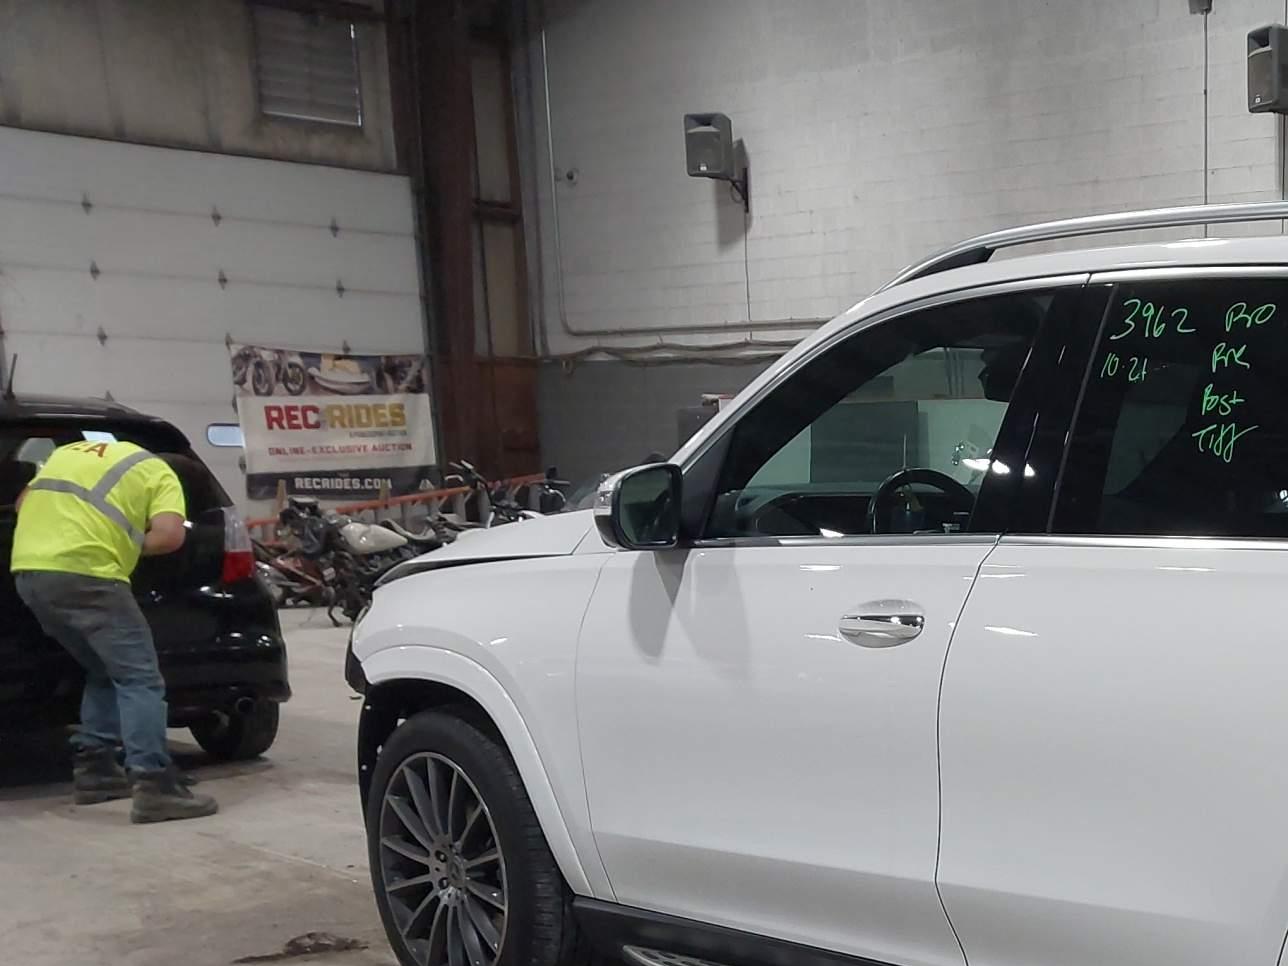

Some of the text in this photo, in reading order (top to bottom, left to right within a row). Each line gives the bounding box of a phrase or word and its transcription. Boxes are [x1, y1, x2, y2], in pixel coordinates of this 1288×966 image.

[1110, 298, 1196, 340] 3962
[264, 403, 406, 430] REC RIDES
[372, 443, 413, 453] AUCTION
